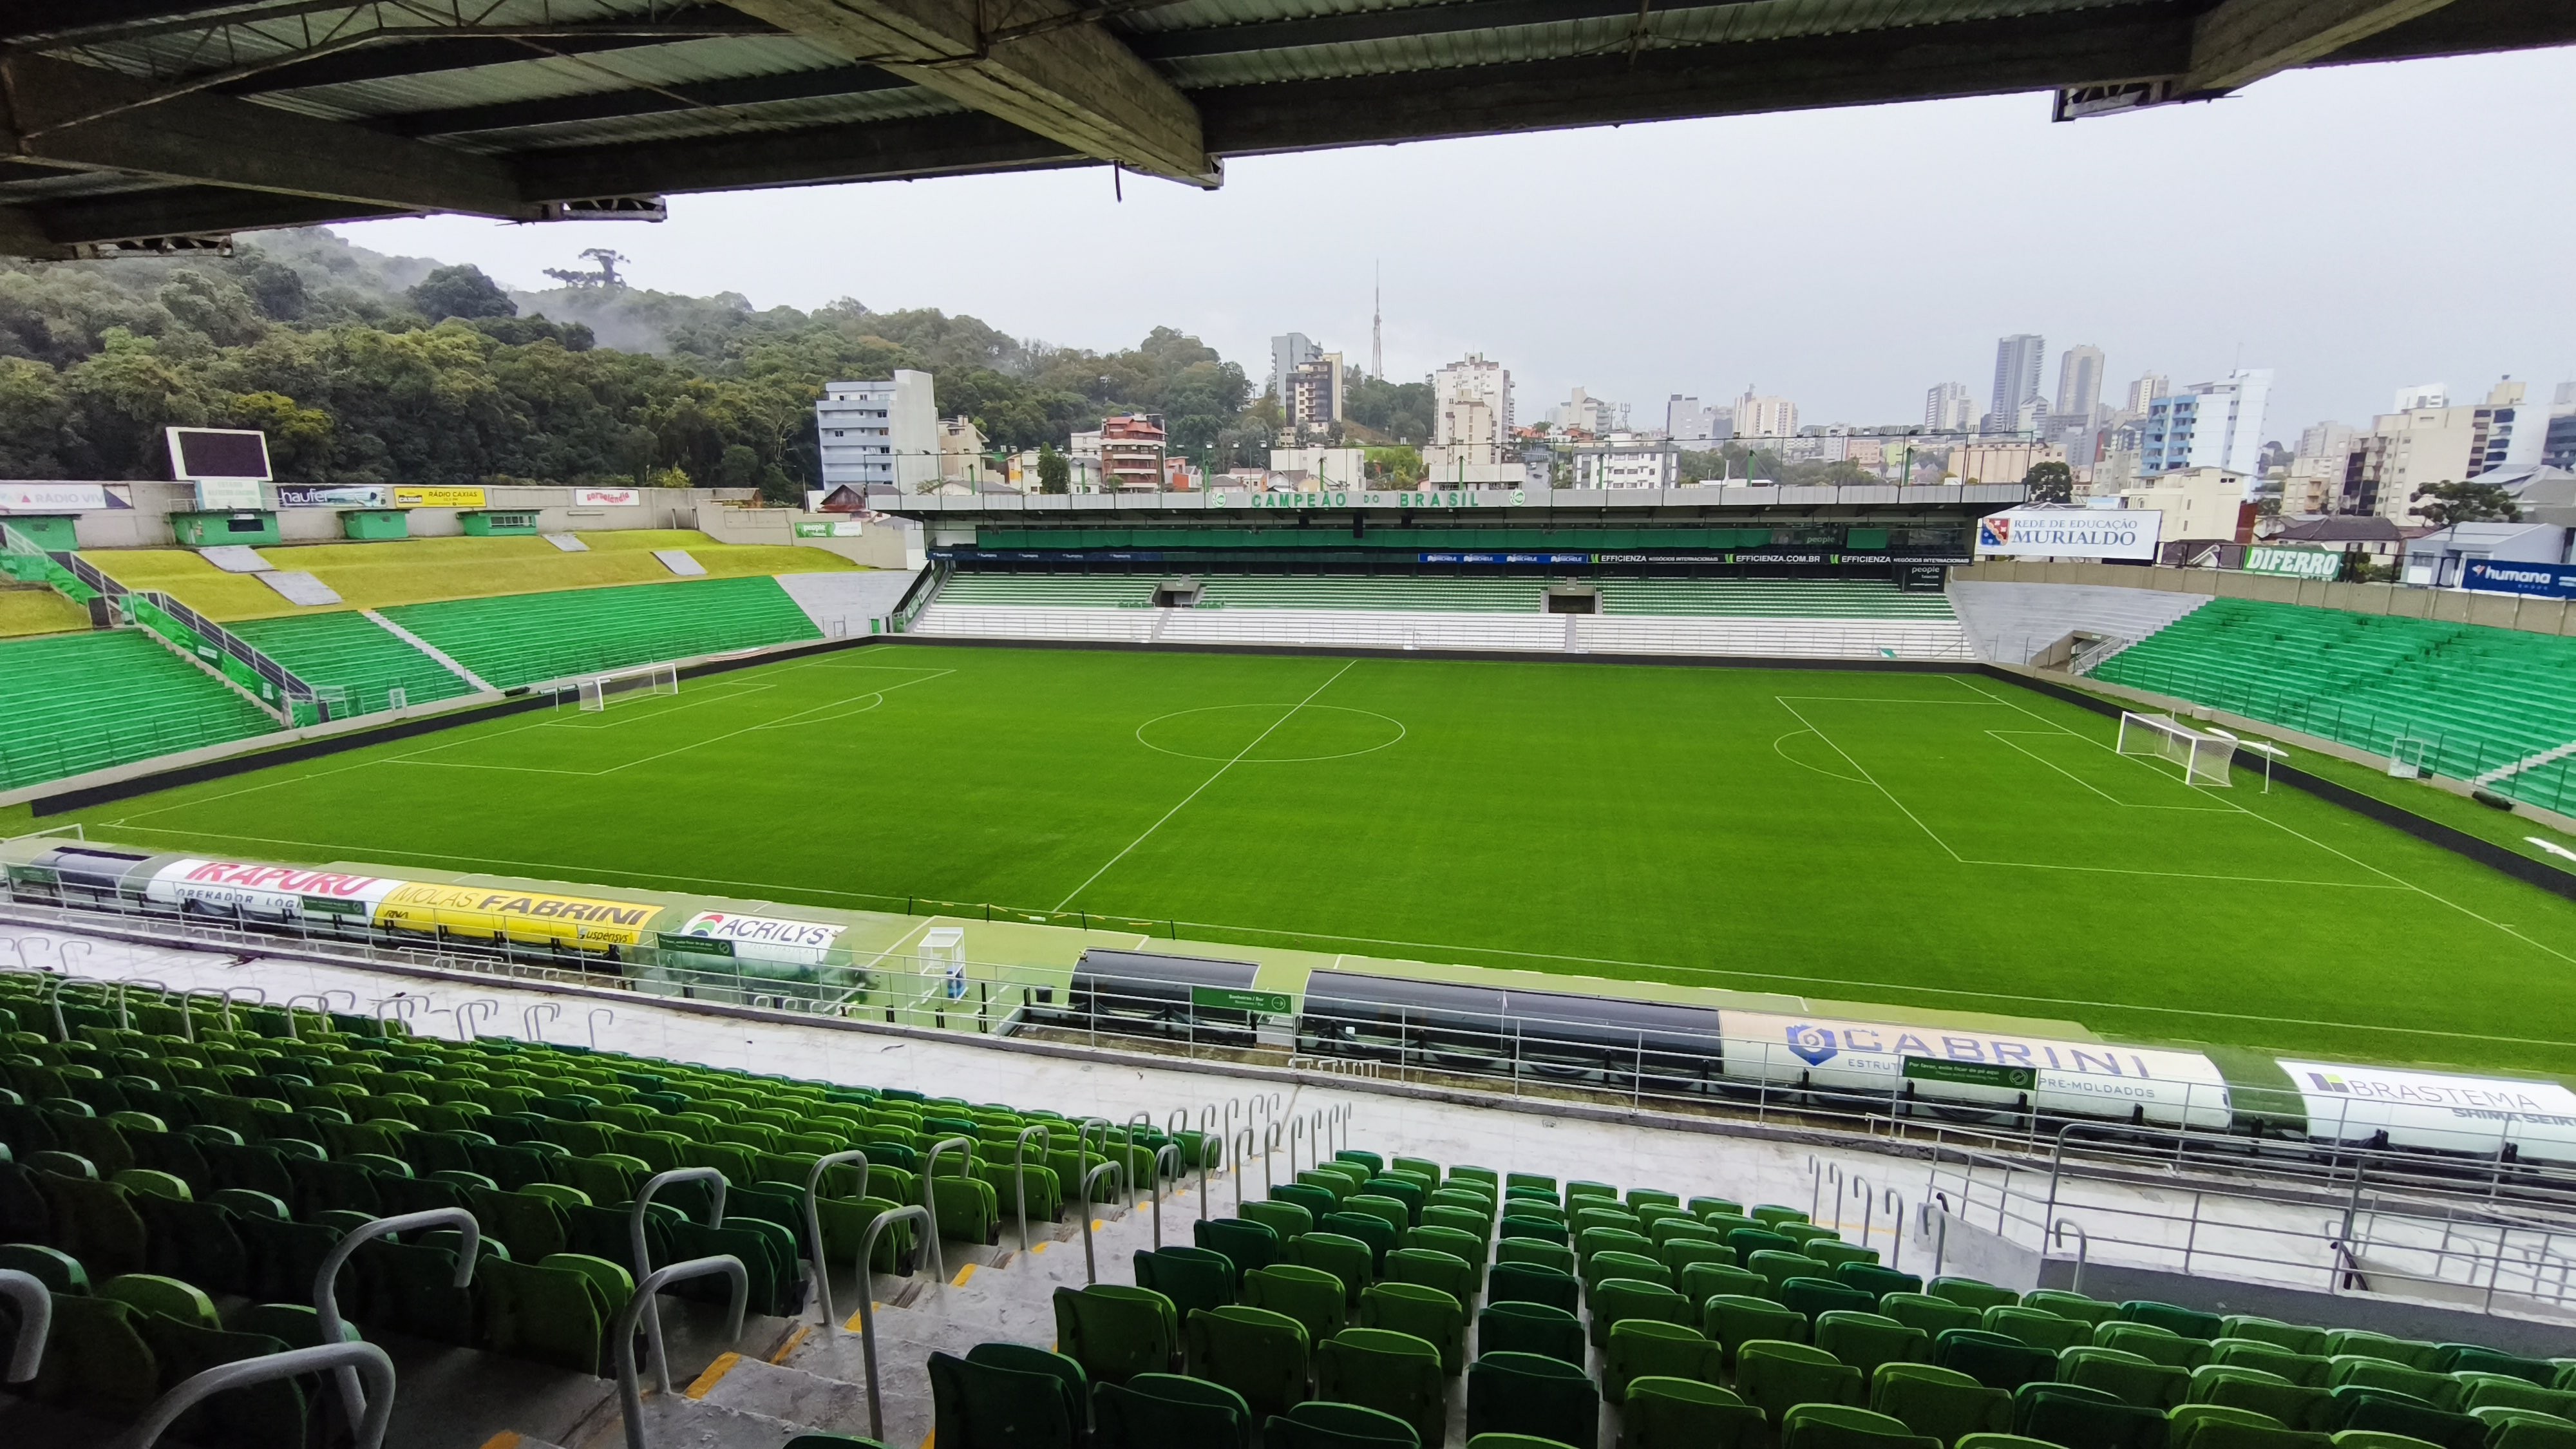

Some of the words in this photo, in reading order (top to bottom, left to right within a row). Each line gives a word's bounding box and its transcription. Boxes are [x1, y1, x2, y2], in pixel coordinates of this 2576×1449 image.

[281, 488, 328, 505] haufer
[1251, 490, 1347, 507] CAMPEÃO
[1364, 495, 1380, 504] DO
[1400, 492, 1479, 507] BRASIL
[2069, 518, 2137, 531] EDUCAÇÃO
[2011, 530, 2136, 546] MURIALDO
[2246, 549, 2338, 575] DIFERRO
[2485, 565, 2552, 584] humana
[185, 862, 377, 896] IRAPURU
[392, 887, 479, 908] MOLAS
[476, 895, 650, 925] FABRINI
[717, 919, 829, 945] ACRILYS
[1843, 1028, 2150, 1077] CABRINI
[2039, 1076, 2155, 1097] PRÉ-MOLDADOS
[2349, 1080, 2543, 1110] BRASTEMA
